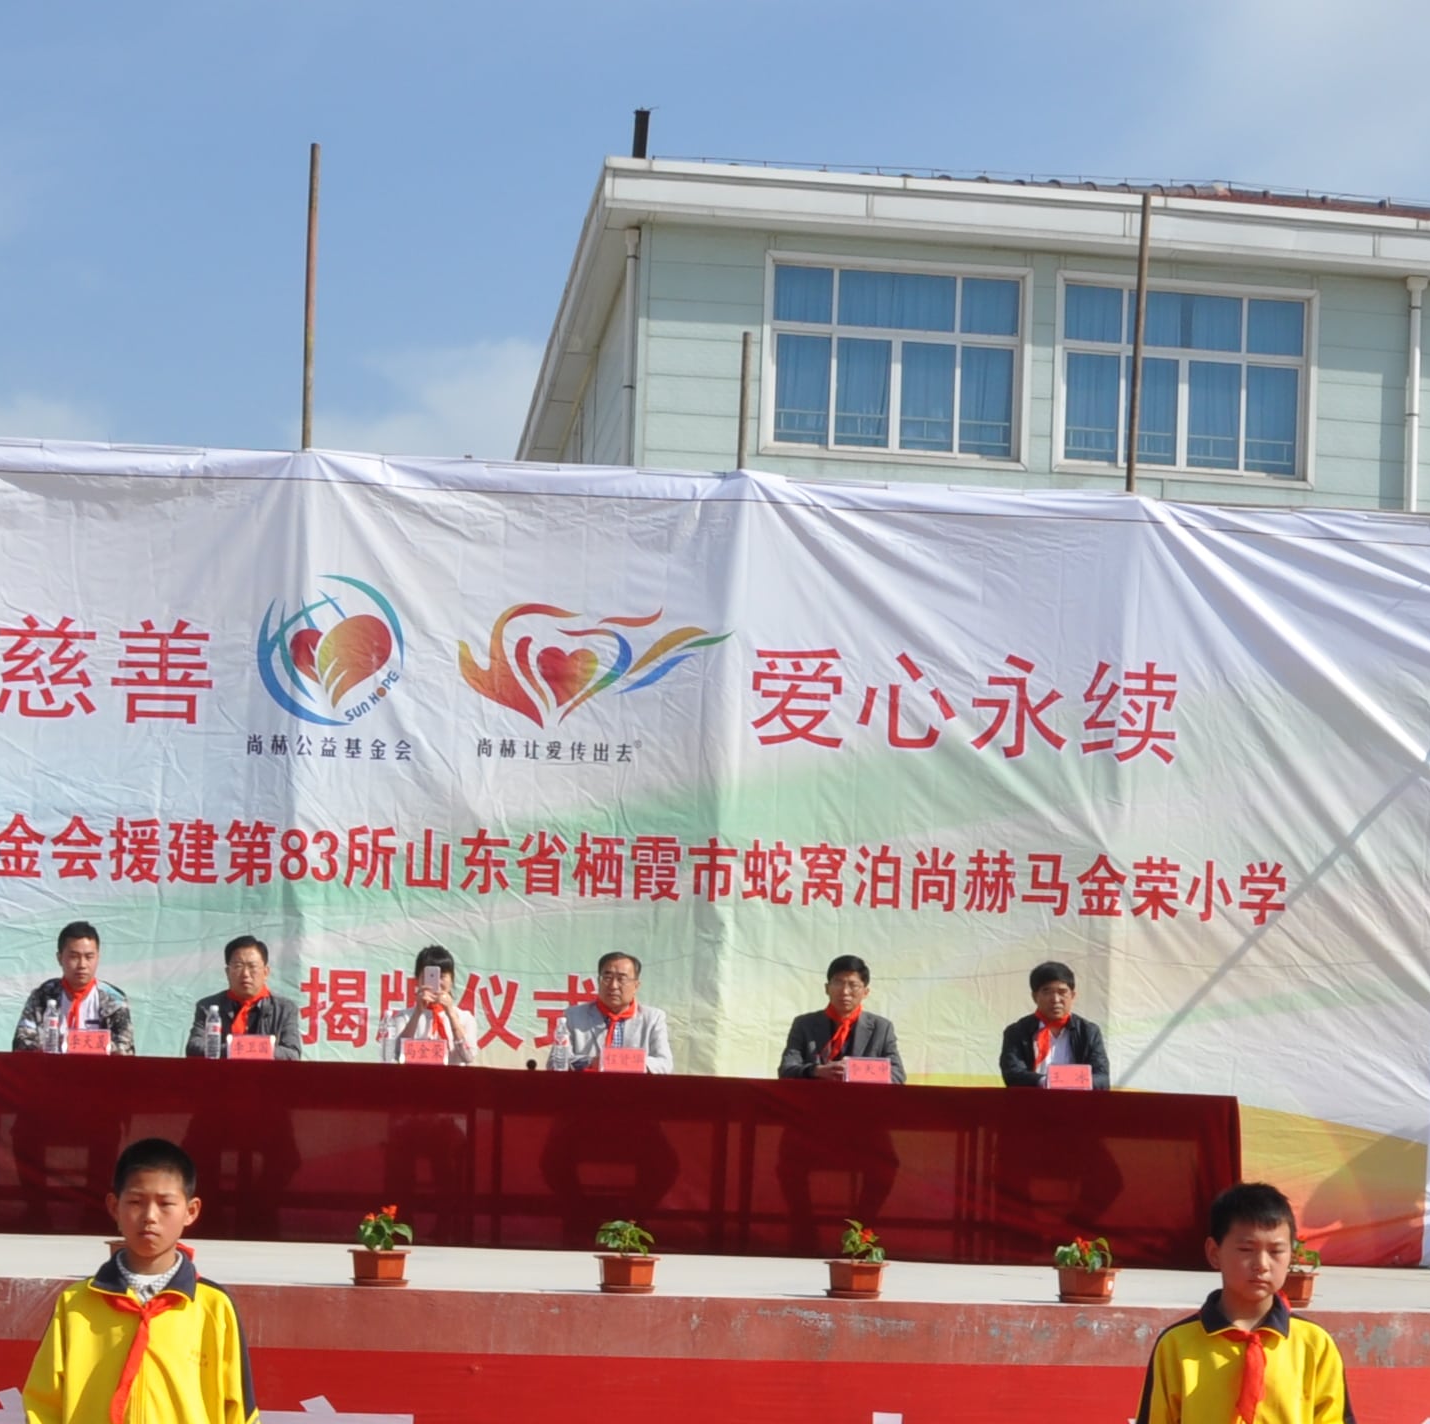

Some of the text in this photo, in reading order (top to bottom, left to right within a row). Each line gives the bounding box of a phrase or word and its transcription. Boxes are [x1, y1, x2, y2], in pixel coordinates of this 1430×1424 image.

[343, 670, 400, 723] SUN HOPE
[751, 647, 1178, 766] 爱心永续
[246, 734, 412, 762] 尚赫公益基金会
[476, 738, 633, 763] 尚赫让爱传出去
